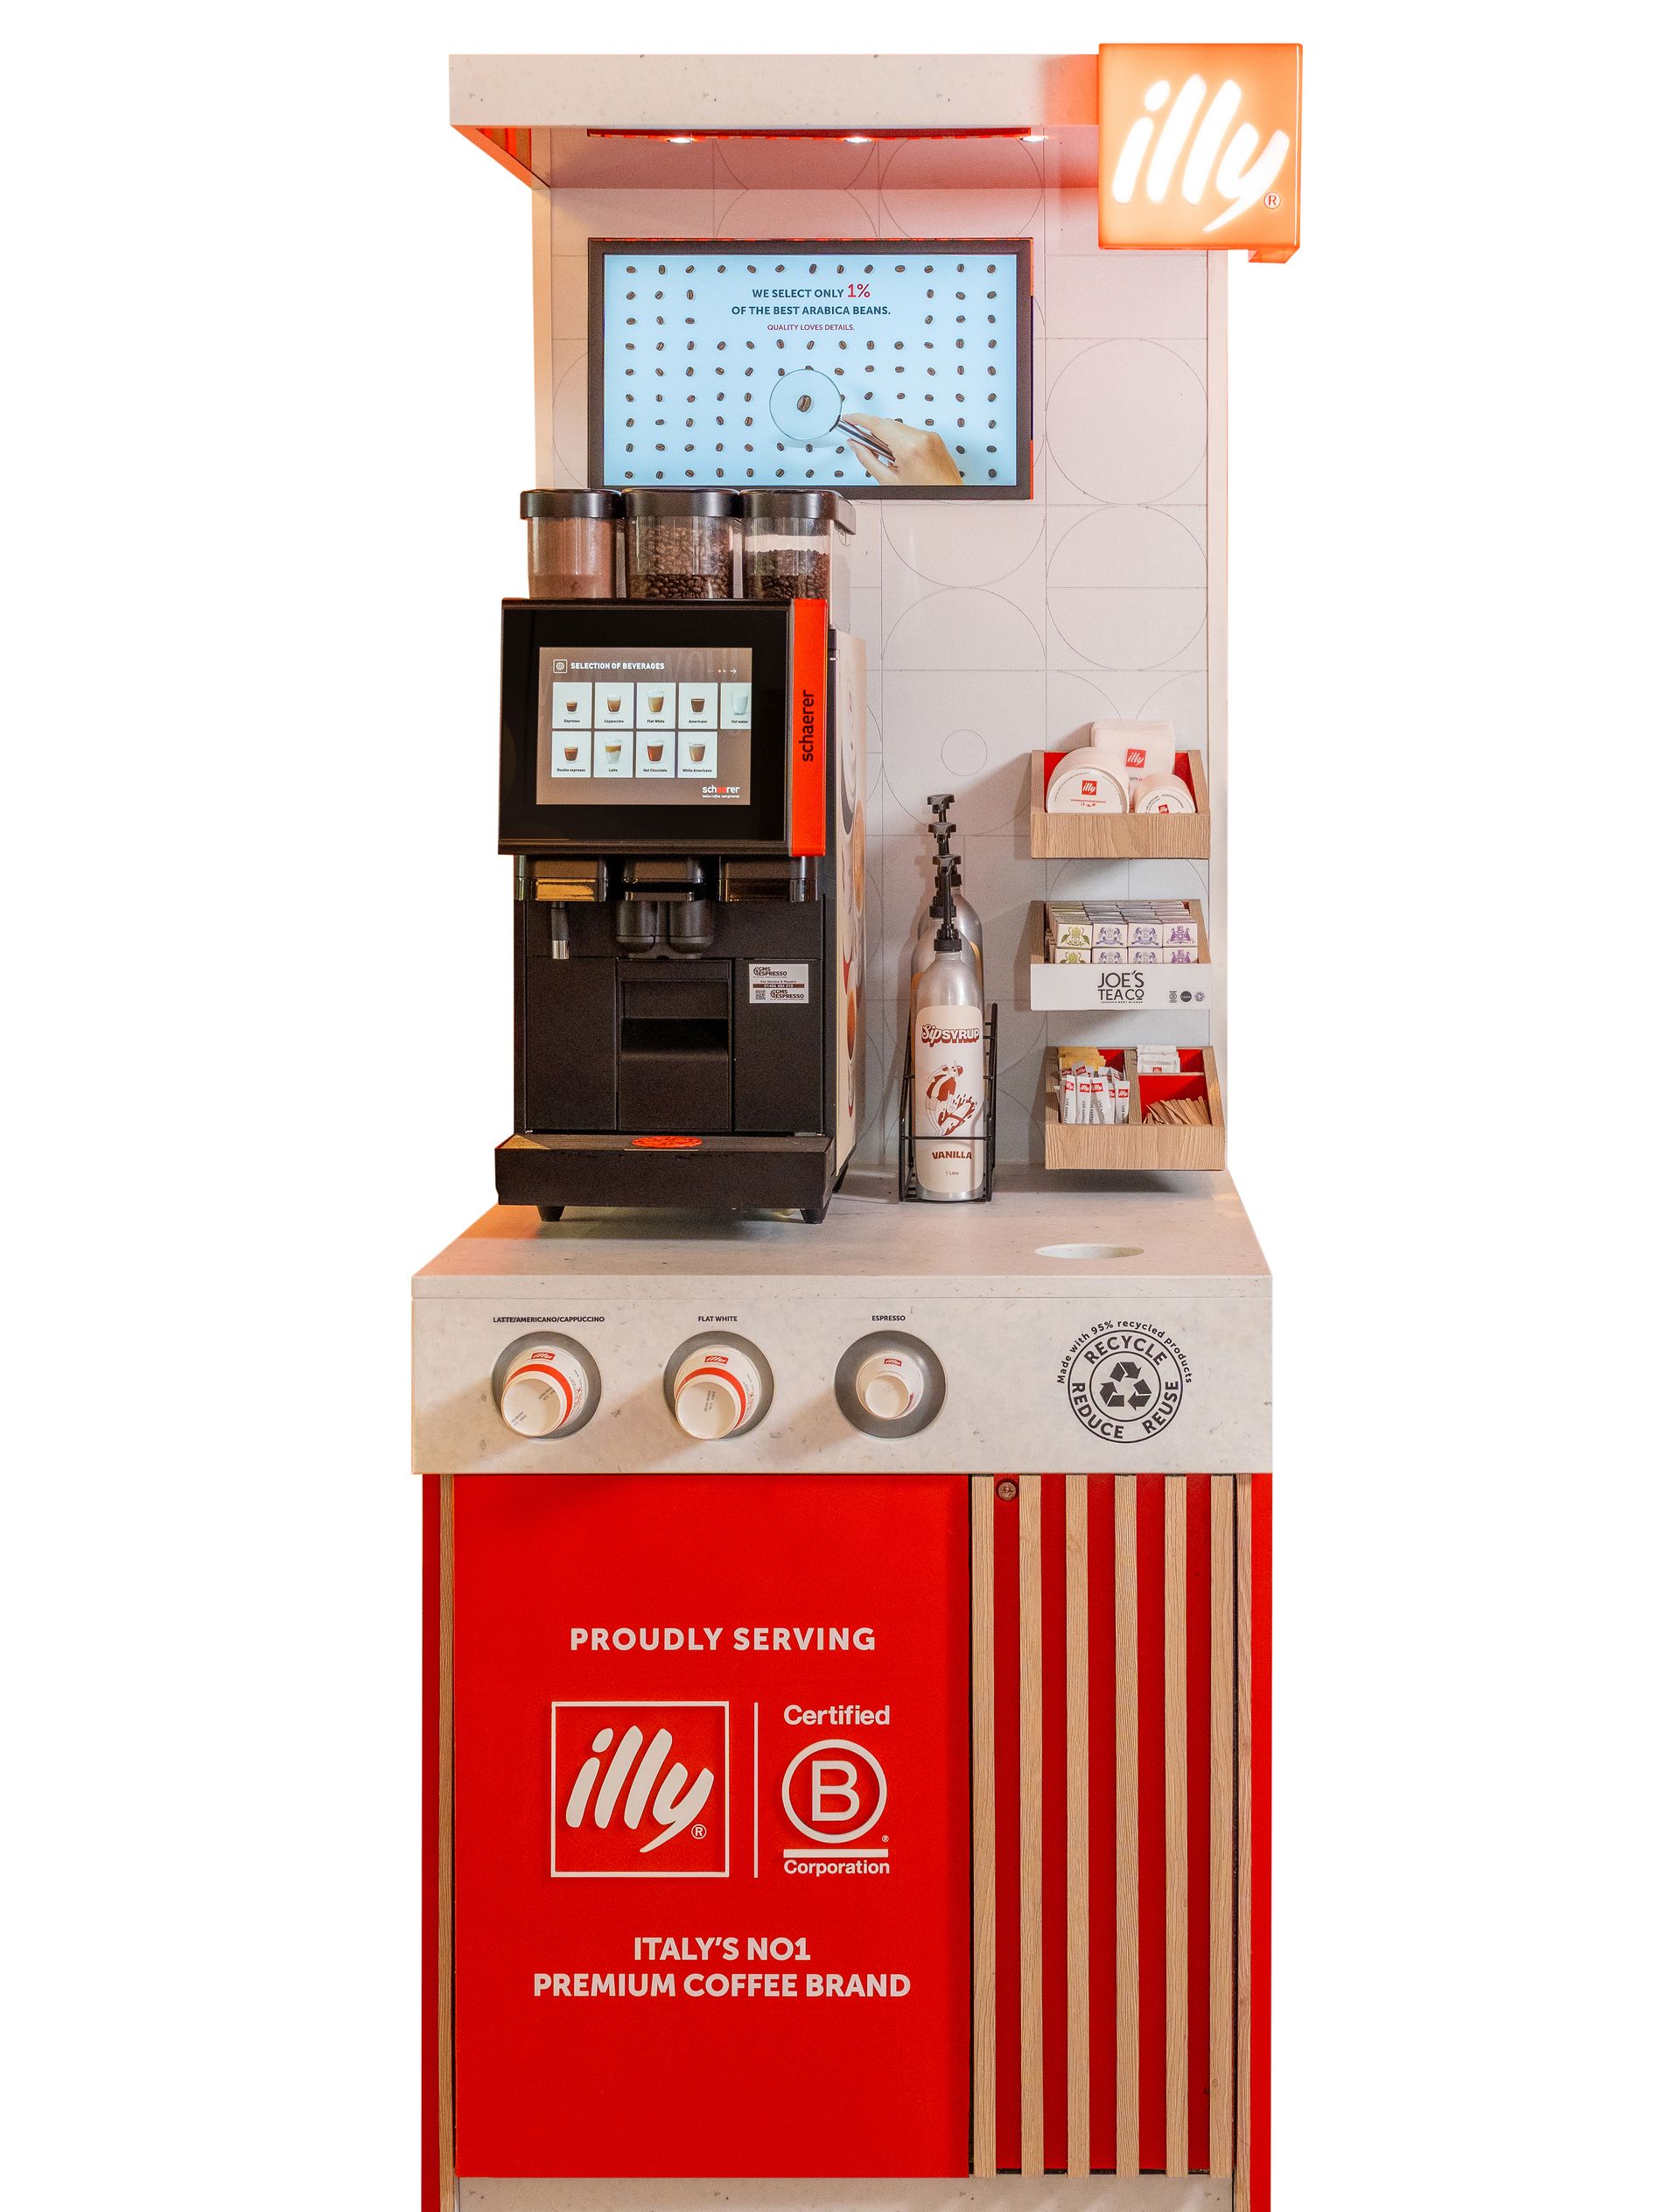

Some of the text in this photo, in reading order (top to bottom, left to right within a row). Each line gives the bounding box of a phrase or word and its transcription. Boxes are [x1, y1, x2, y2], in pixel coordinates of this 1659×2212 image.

[1112, 74, 1290, 233] illy
[752, 284, 871, 298] WE SELECT ONLY 1%
[732, 306, 891, 315] OF THE BEST ARABICA BEANS.
[798, 690, 814, 762] schaerer
[1128, 752, 1144, 766] illy
[702, 785, 740, 793] schaerer
[1083, 783, 1096, 794] illy
[1098, 970, 1144, 988] JOE'S
[1098, 989, 1123, 1000] TEA
[932, 1150, 972, 1160] VANILLA
[1057, 1320, 1192, 1384] Made with 95% recycled products
[1084, 1335, 1168, 1366] RECYCLE
[1072, 1382, 1124, 1439] REDUCE
[1141, 1381, 1179, 1434] REUSE
[570, 1627, 876, 1651] PROUDLY SERVING
[784, 1705, 891, 1725] Certified
[566, 1726, 714, 1853] illy
[812, 1760, 860, 1821] B
[784, 1859, 890, 1877] Corporation
[634, 1937, 811, 1961] ITALY'S NO1
[534, 1973, 911, 1997] PREMIUM COFFEE BRAND
